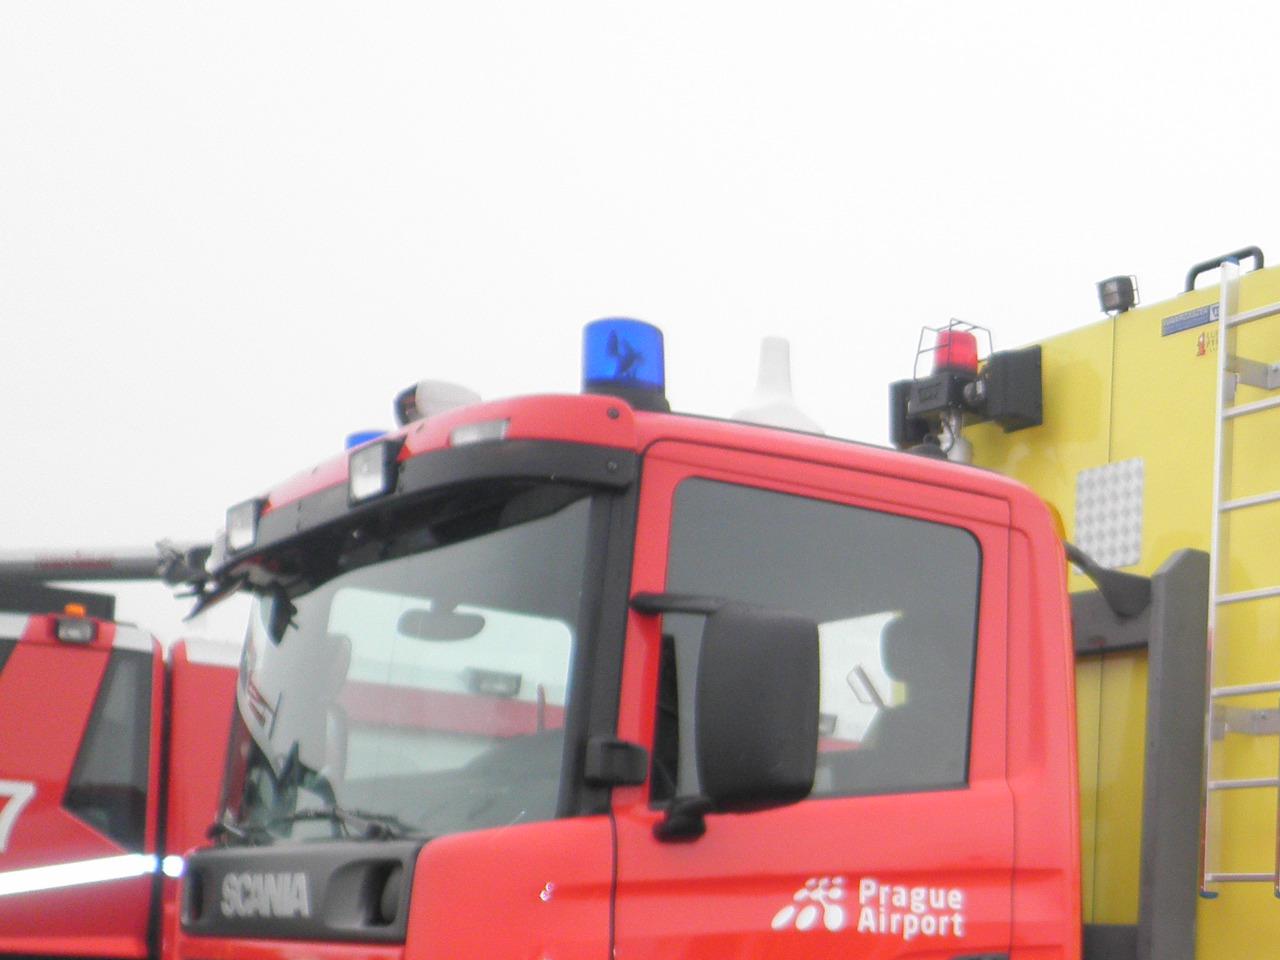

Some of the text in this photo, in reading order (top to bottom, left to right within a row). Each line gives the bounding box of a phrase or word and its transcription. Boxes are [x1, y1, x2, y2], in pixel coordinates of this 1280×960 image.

[221, 872, 310, 918] SCANIA
[859, 879, 964, 913] Prague
[857, 906, 966, 941] Airport
